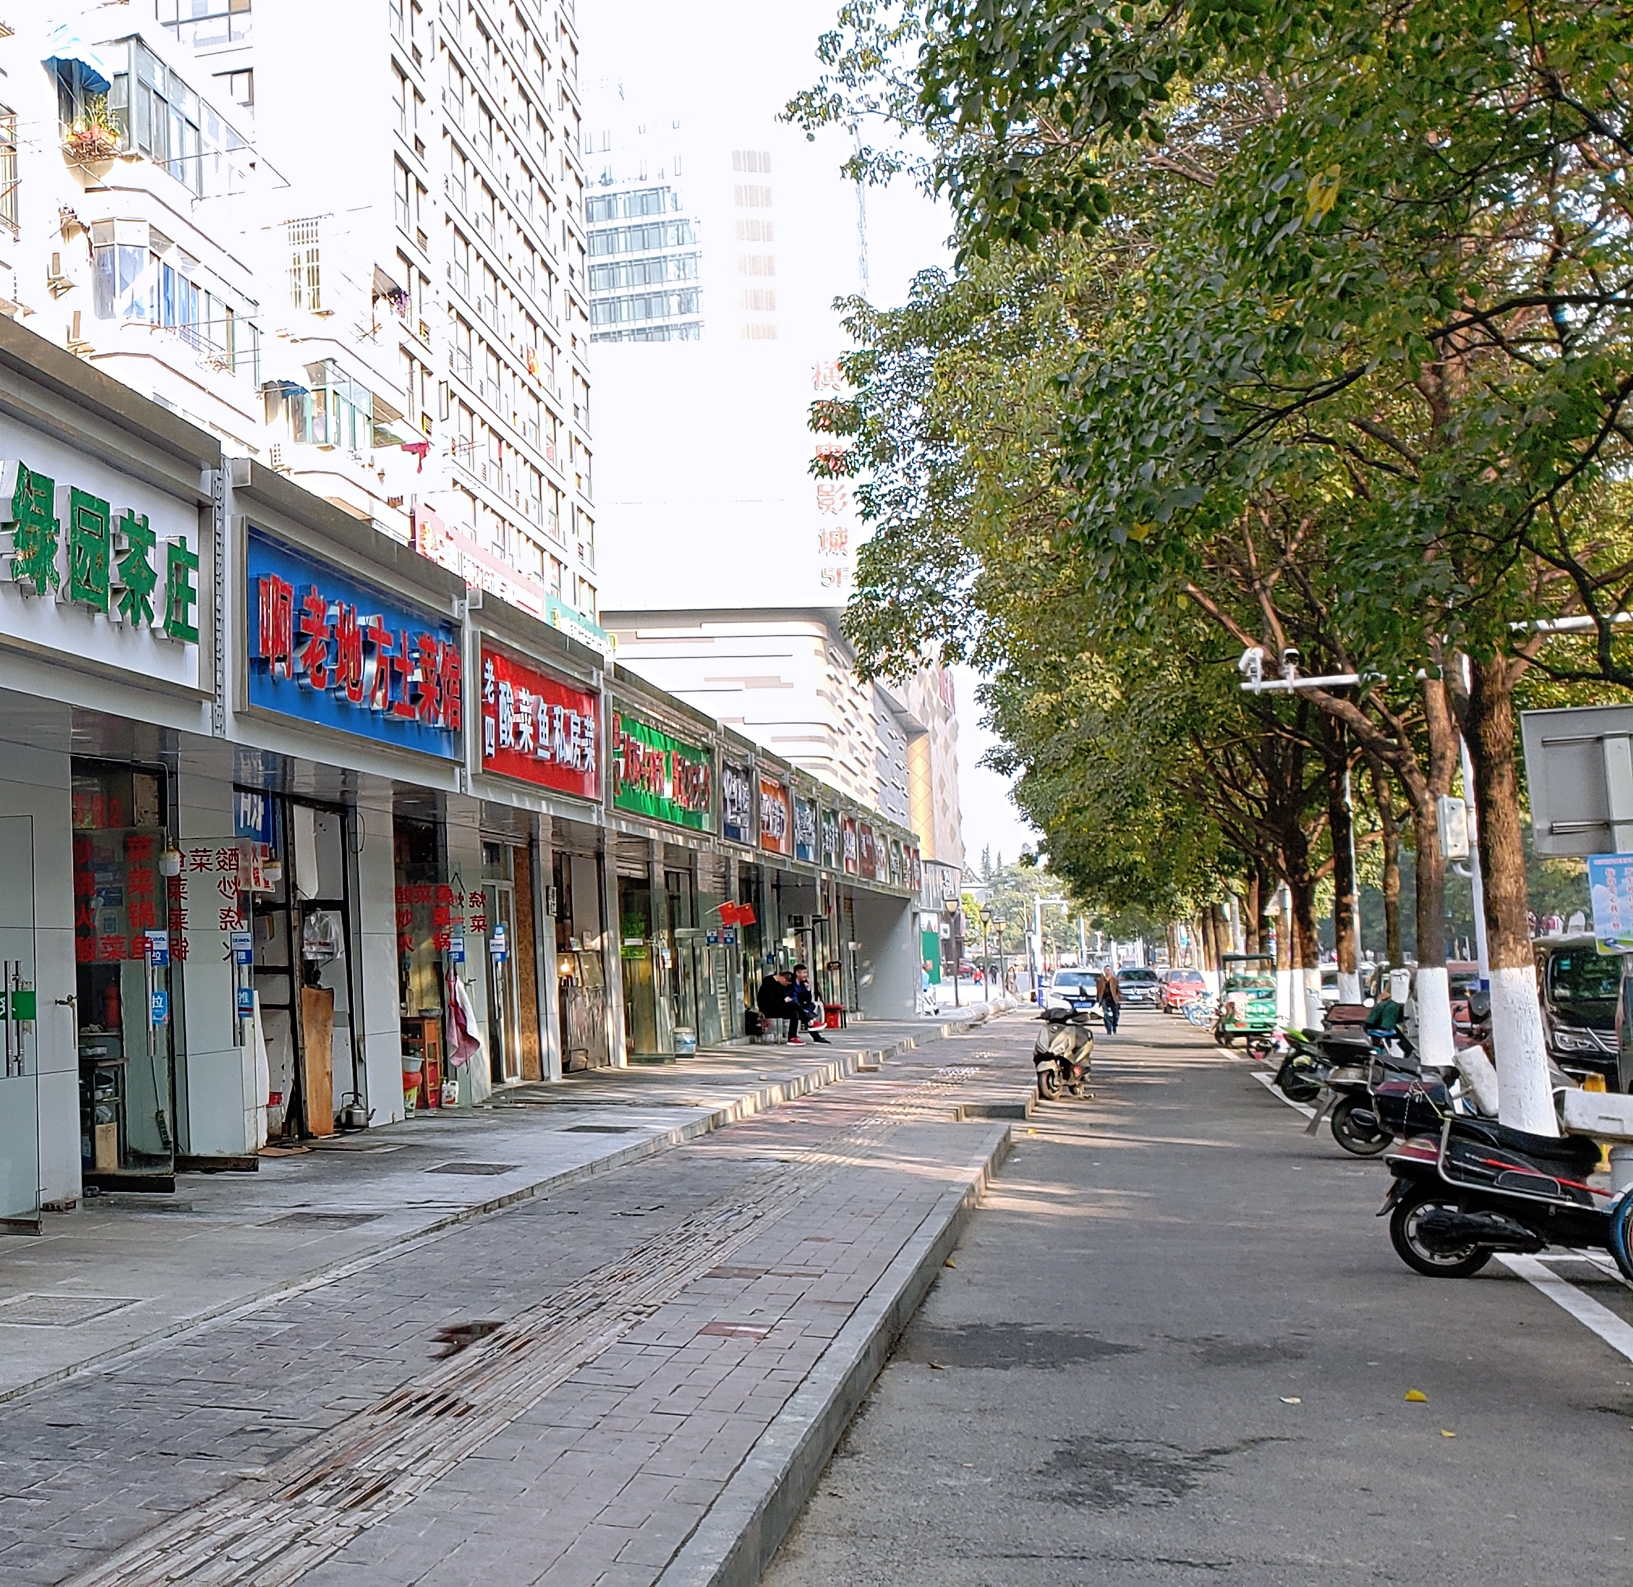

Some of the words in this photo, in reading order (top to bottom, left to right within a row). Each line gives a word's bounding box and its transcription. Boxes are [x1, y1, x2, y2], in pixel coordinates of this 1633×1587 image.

[811, 360, 849, 557] 横影城
[483, 658, 496, 758] 老四
[498, 681, 596, 773] 酸菜鱼私房菜
